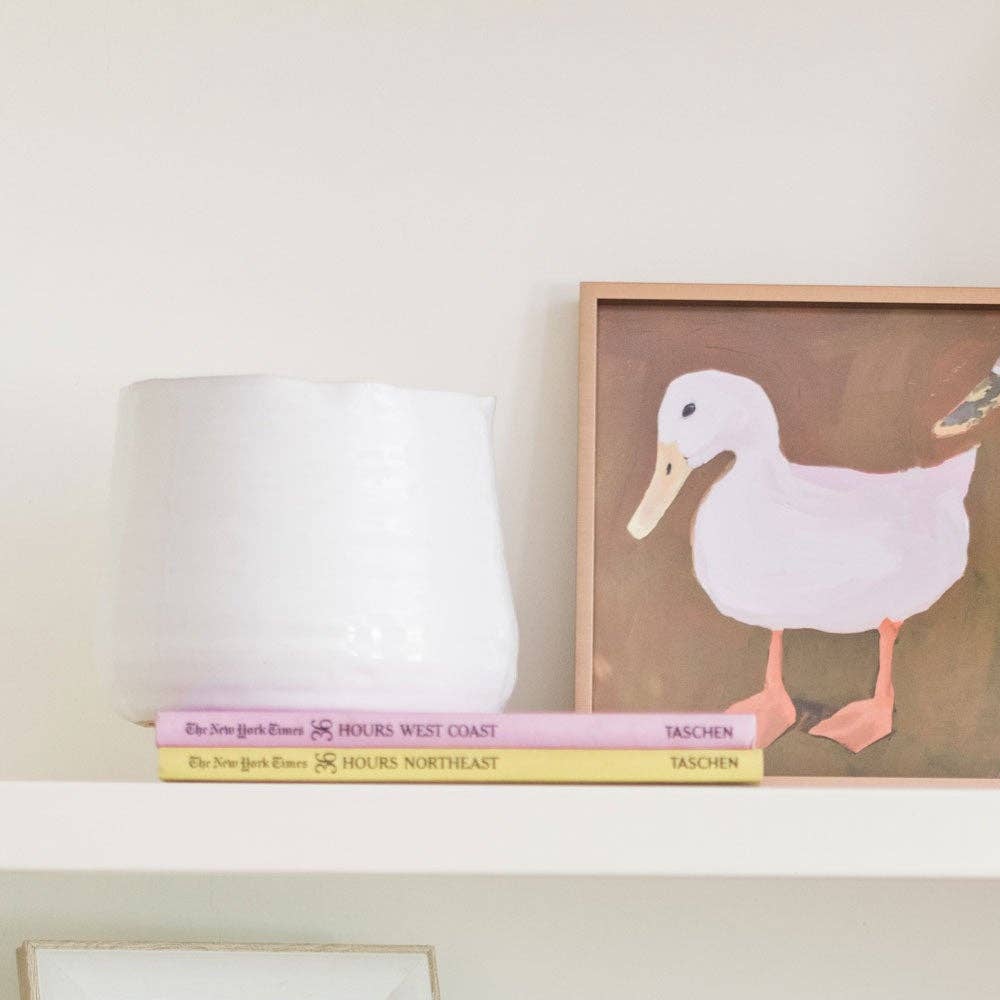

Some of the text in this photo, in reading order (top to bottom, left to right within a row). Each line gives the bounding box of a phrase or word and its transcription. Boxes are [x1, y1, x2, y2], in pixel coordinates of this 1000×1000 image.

[185, 722, 207, 735] The
[210, 723, 235, 736] New
[237, 723, 266, 738] York
[268, 723, 304, 736] Times
[339, 724, 394, 737] HOURS
[400, 724, 443, 738] WEST
[448, 724, 498, 738] COAST
[665, 725, 734, 739] TASCHEN
[188, 756, 210, 769] The
[213, 756, 238, 769] New
[240, 757, 270, 772] York
[272, 756, 308, 769] Times
[343, 757, 398, 770] HOURS
[404, 757, 499, 770] NORTHEAST
[670, 757, 739, 770] TASCHEN
